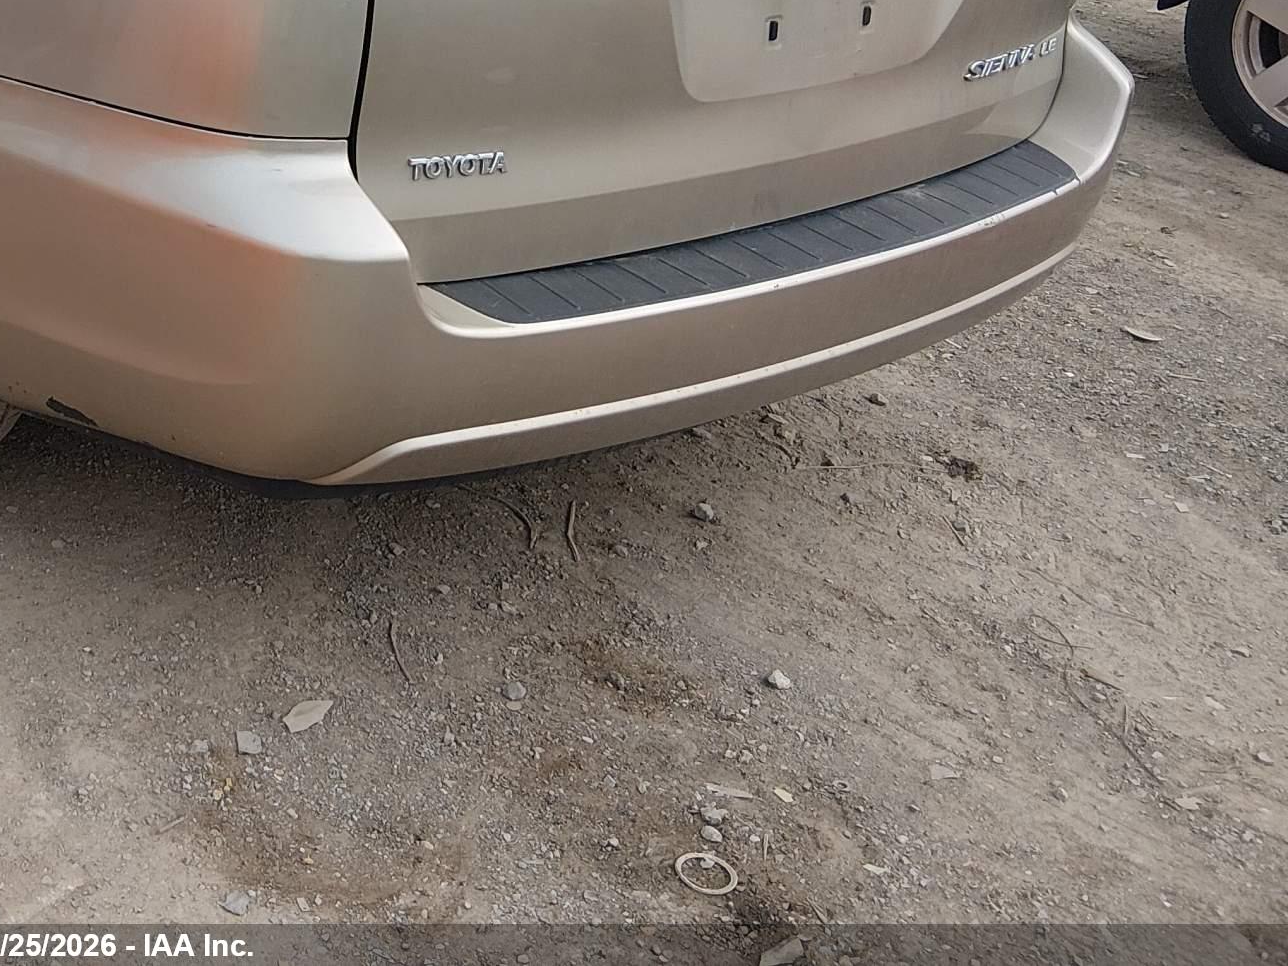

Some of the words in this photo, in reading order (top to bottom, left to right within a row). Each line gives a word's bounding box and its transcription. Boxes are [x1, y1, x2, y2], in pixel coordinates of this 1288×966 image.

[963, 43, 1035, 81] SIENNA
[1039, 38, 1057, 56] LE
[408, 151, 506, 181] TOYOTA
